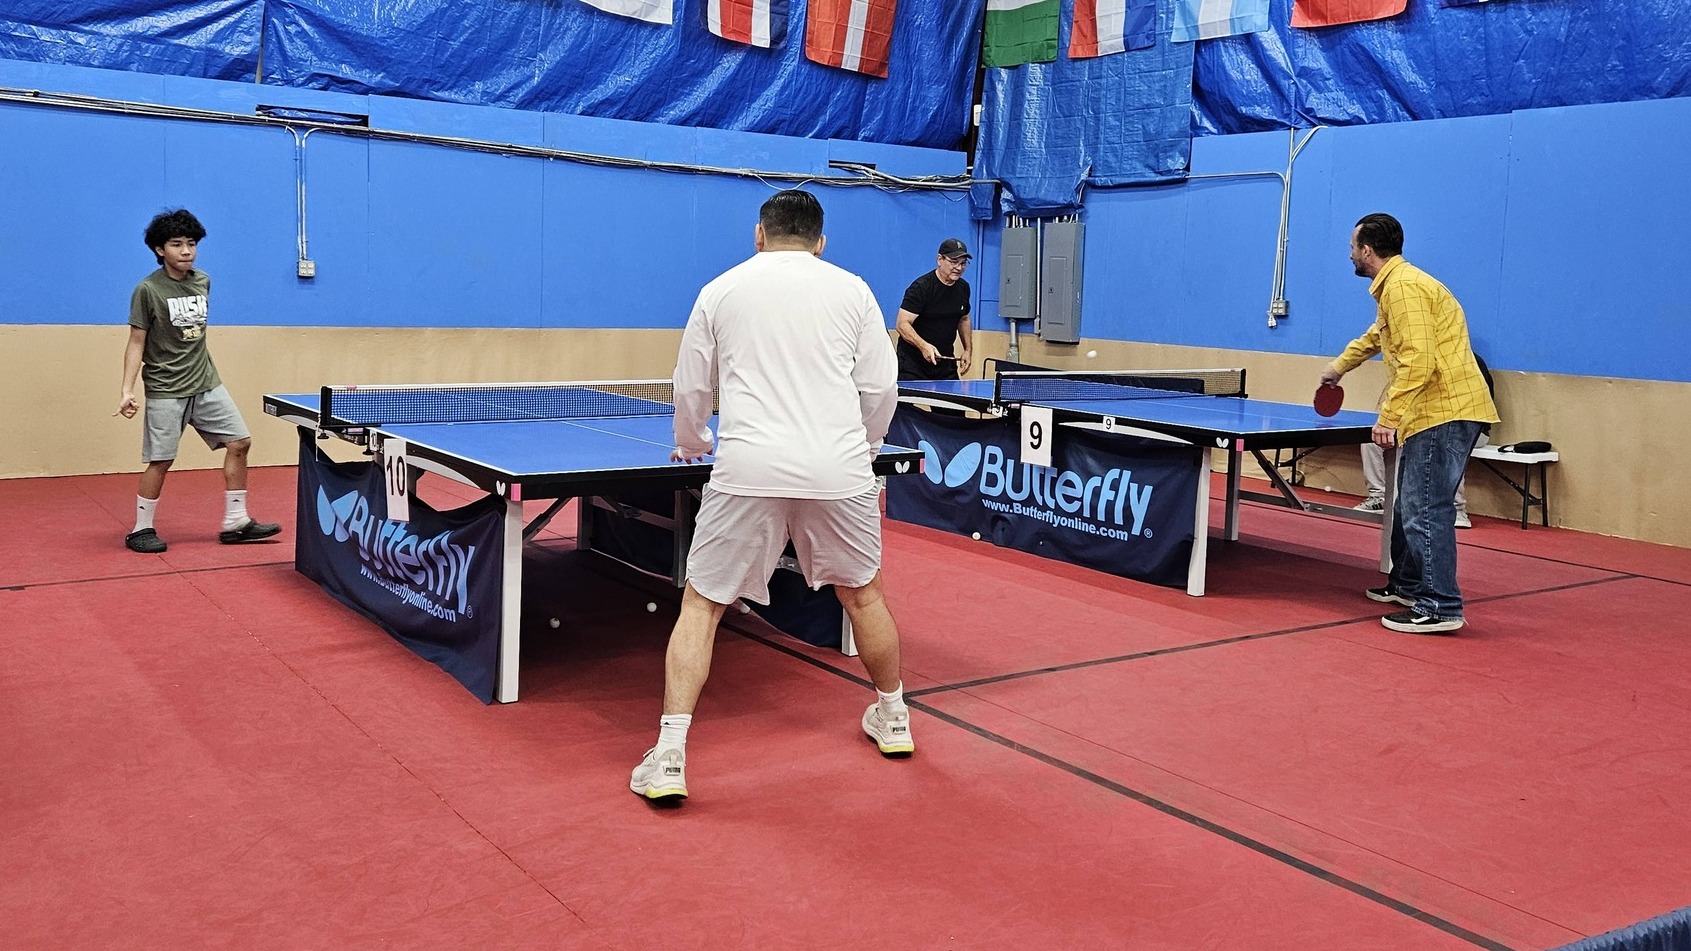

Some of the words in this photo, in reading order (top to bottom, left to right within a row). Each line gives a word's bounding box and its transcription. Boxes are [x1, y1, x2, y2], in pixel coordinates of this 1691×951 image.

[1029, 421, 1042, 450] 9
[1105, 418, 1112, 429] 9
[386, 455, 406, 497] 10
[979, 445, 1153, 536] Butterfly
[982, 498, 1128, 541] www.Butterflyonline.com
[348, 495, 475, 615] Butterfly
